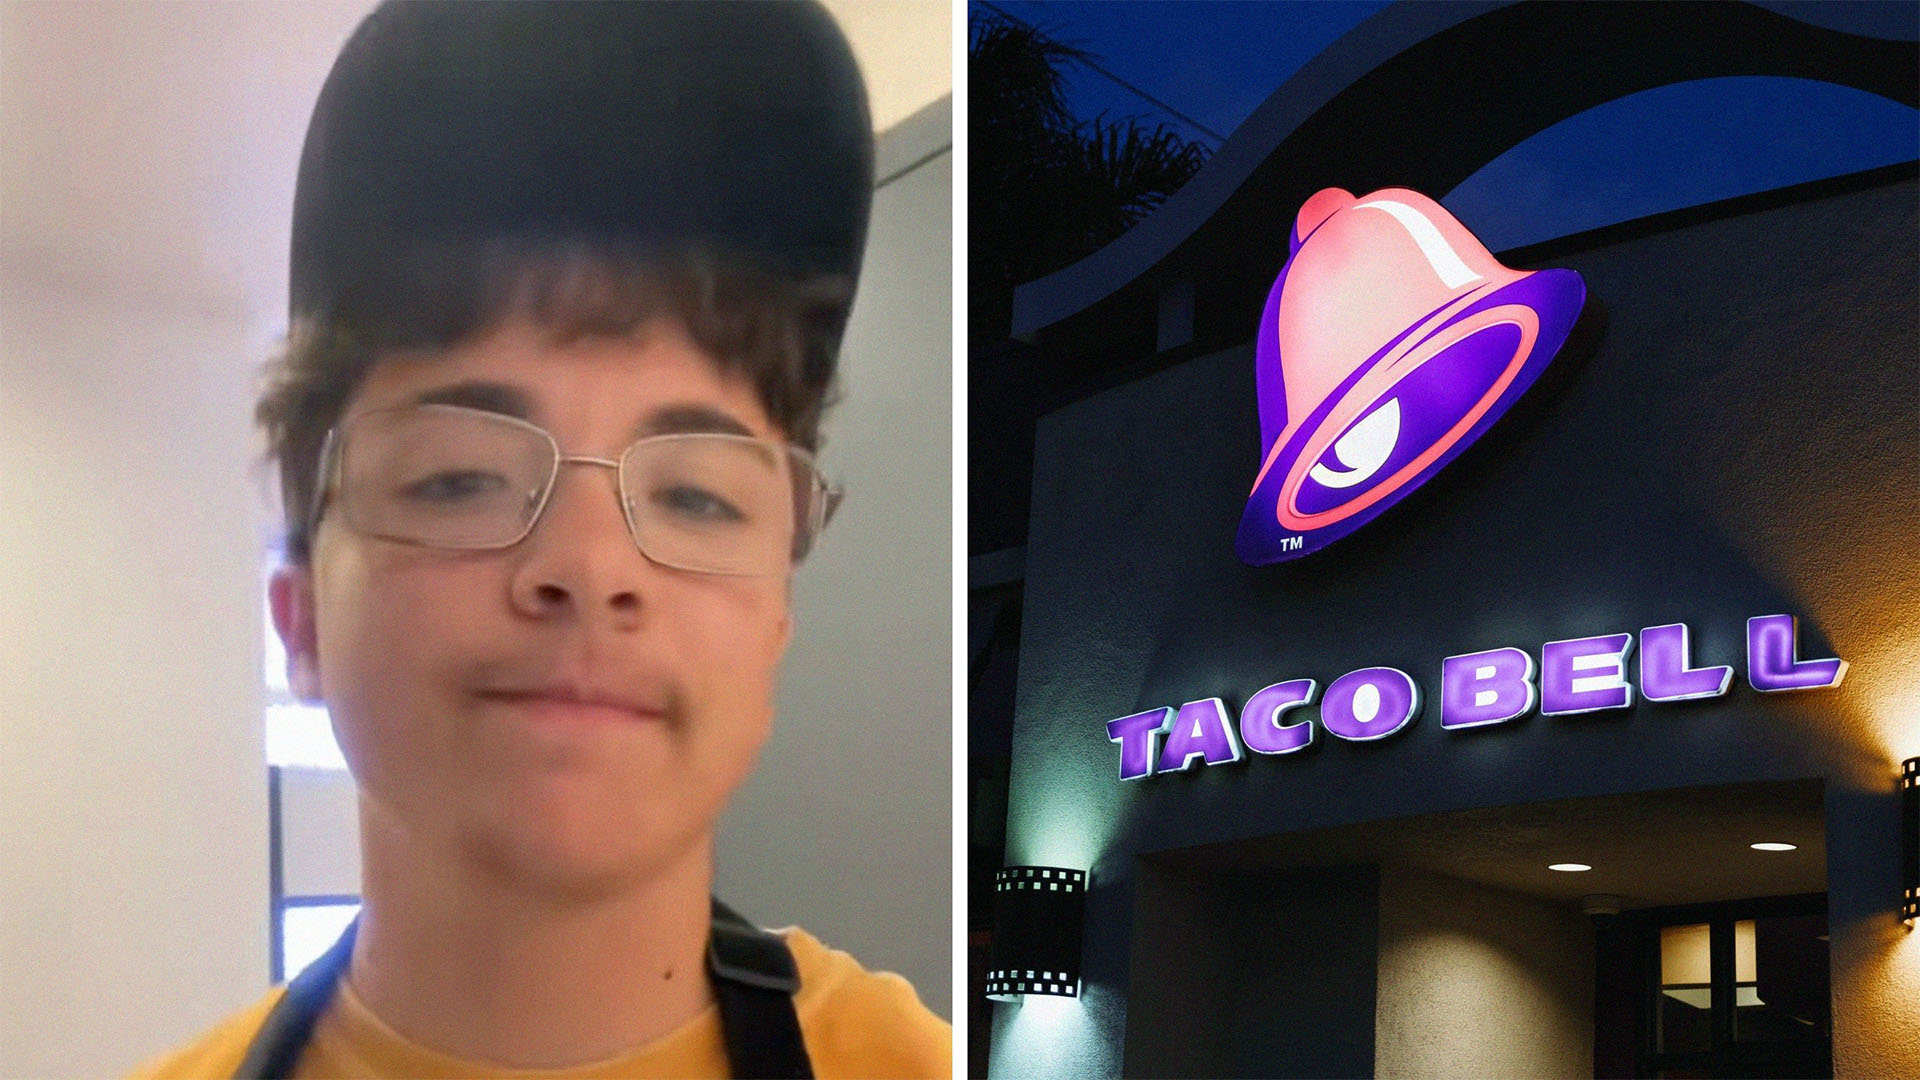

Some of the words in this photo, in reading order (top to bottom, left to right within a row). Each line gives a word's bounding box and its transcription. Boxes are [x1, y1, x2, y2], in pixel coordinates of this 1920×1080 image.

[1280, 535, 1303, 552] TM
[1107, 667, 1421, 781] TACO
[1441, 614, 1847, 730] BELL
